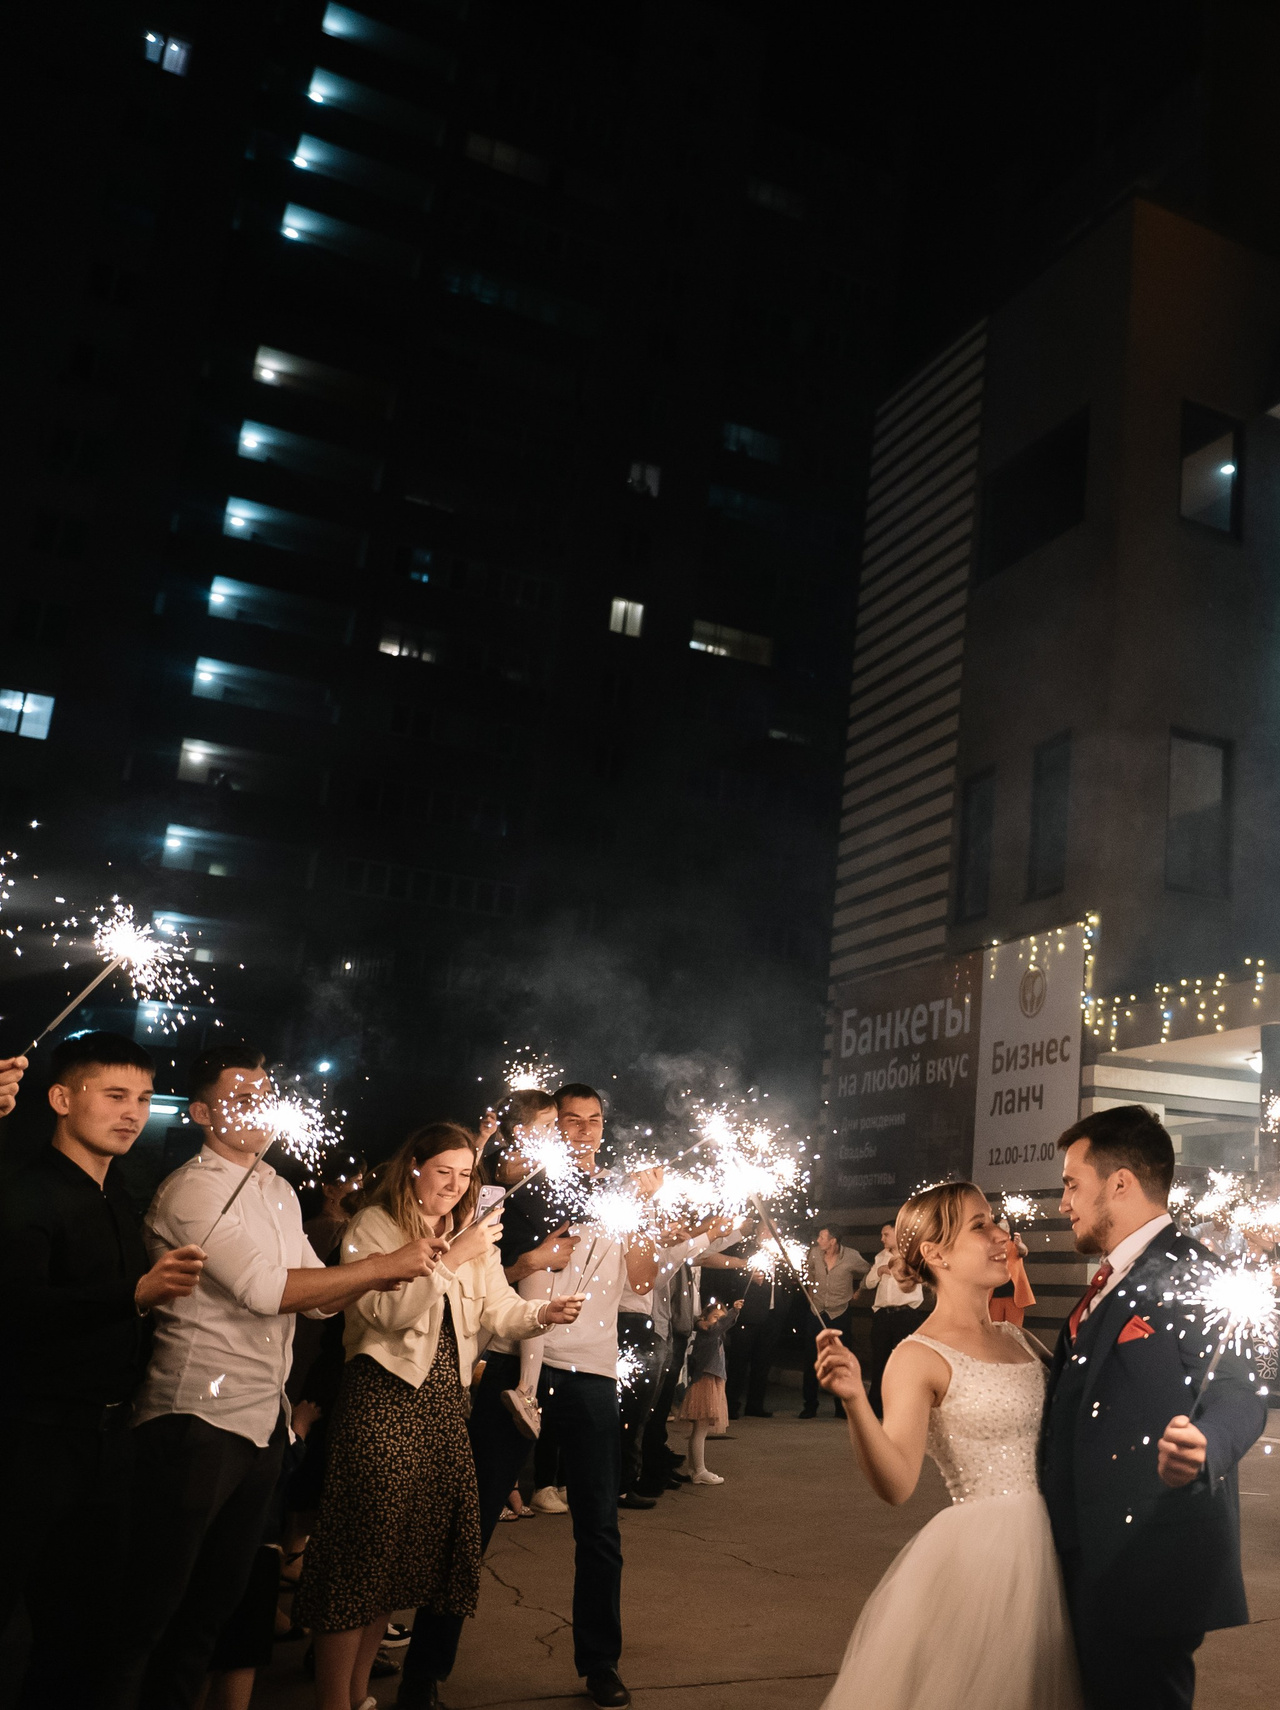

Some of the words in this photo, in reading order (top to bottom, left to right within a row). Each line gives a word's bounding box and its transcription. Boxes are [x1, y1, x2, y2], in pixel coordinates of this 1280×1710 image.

[840, 994, 971, 1058] Банкеты
[838, 1072, 856, 1097] на
[861, 1053, 920, 1095] любой
[926, 1053, 970, 1088] вкус
[991, 1035, 1071, 1075] Бизнес
[989, 1083, 1044, 1117] ланч
[988, 1142, 1055, 1166] 12.00-17.00
